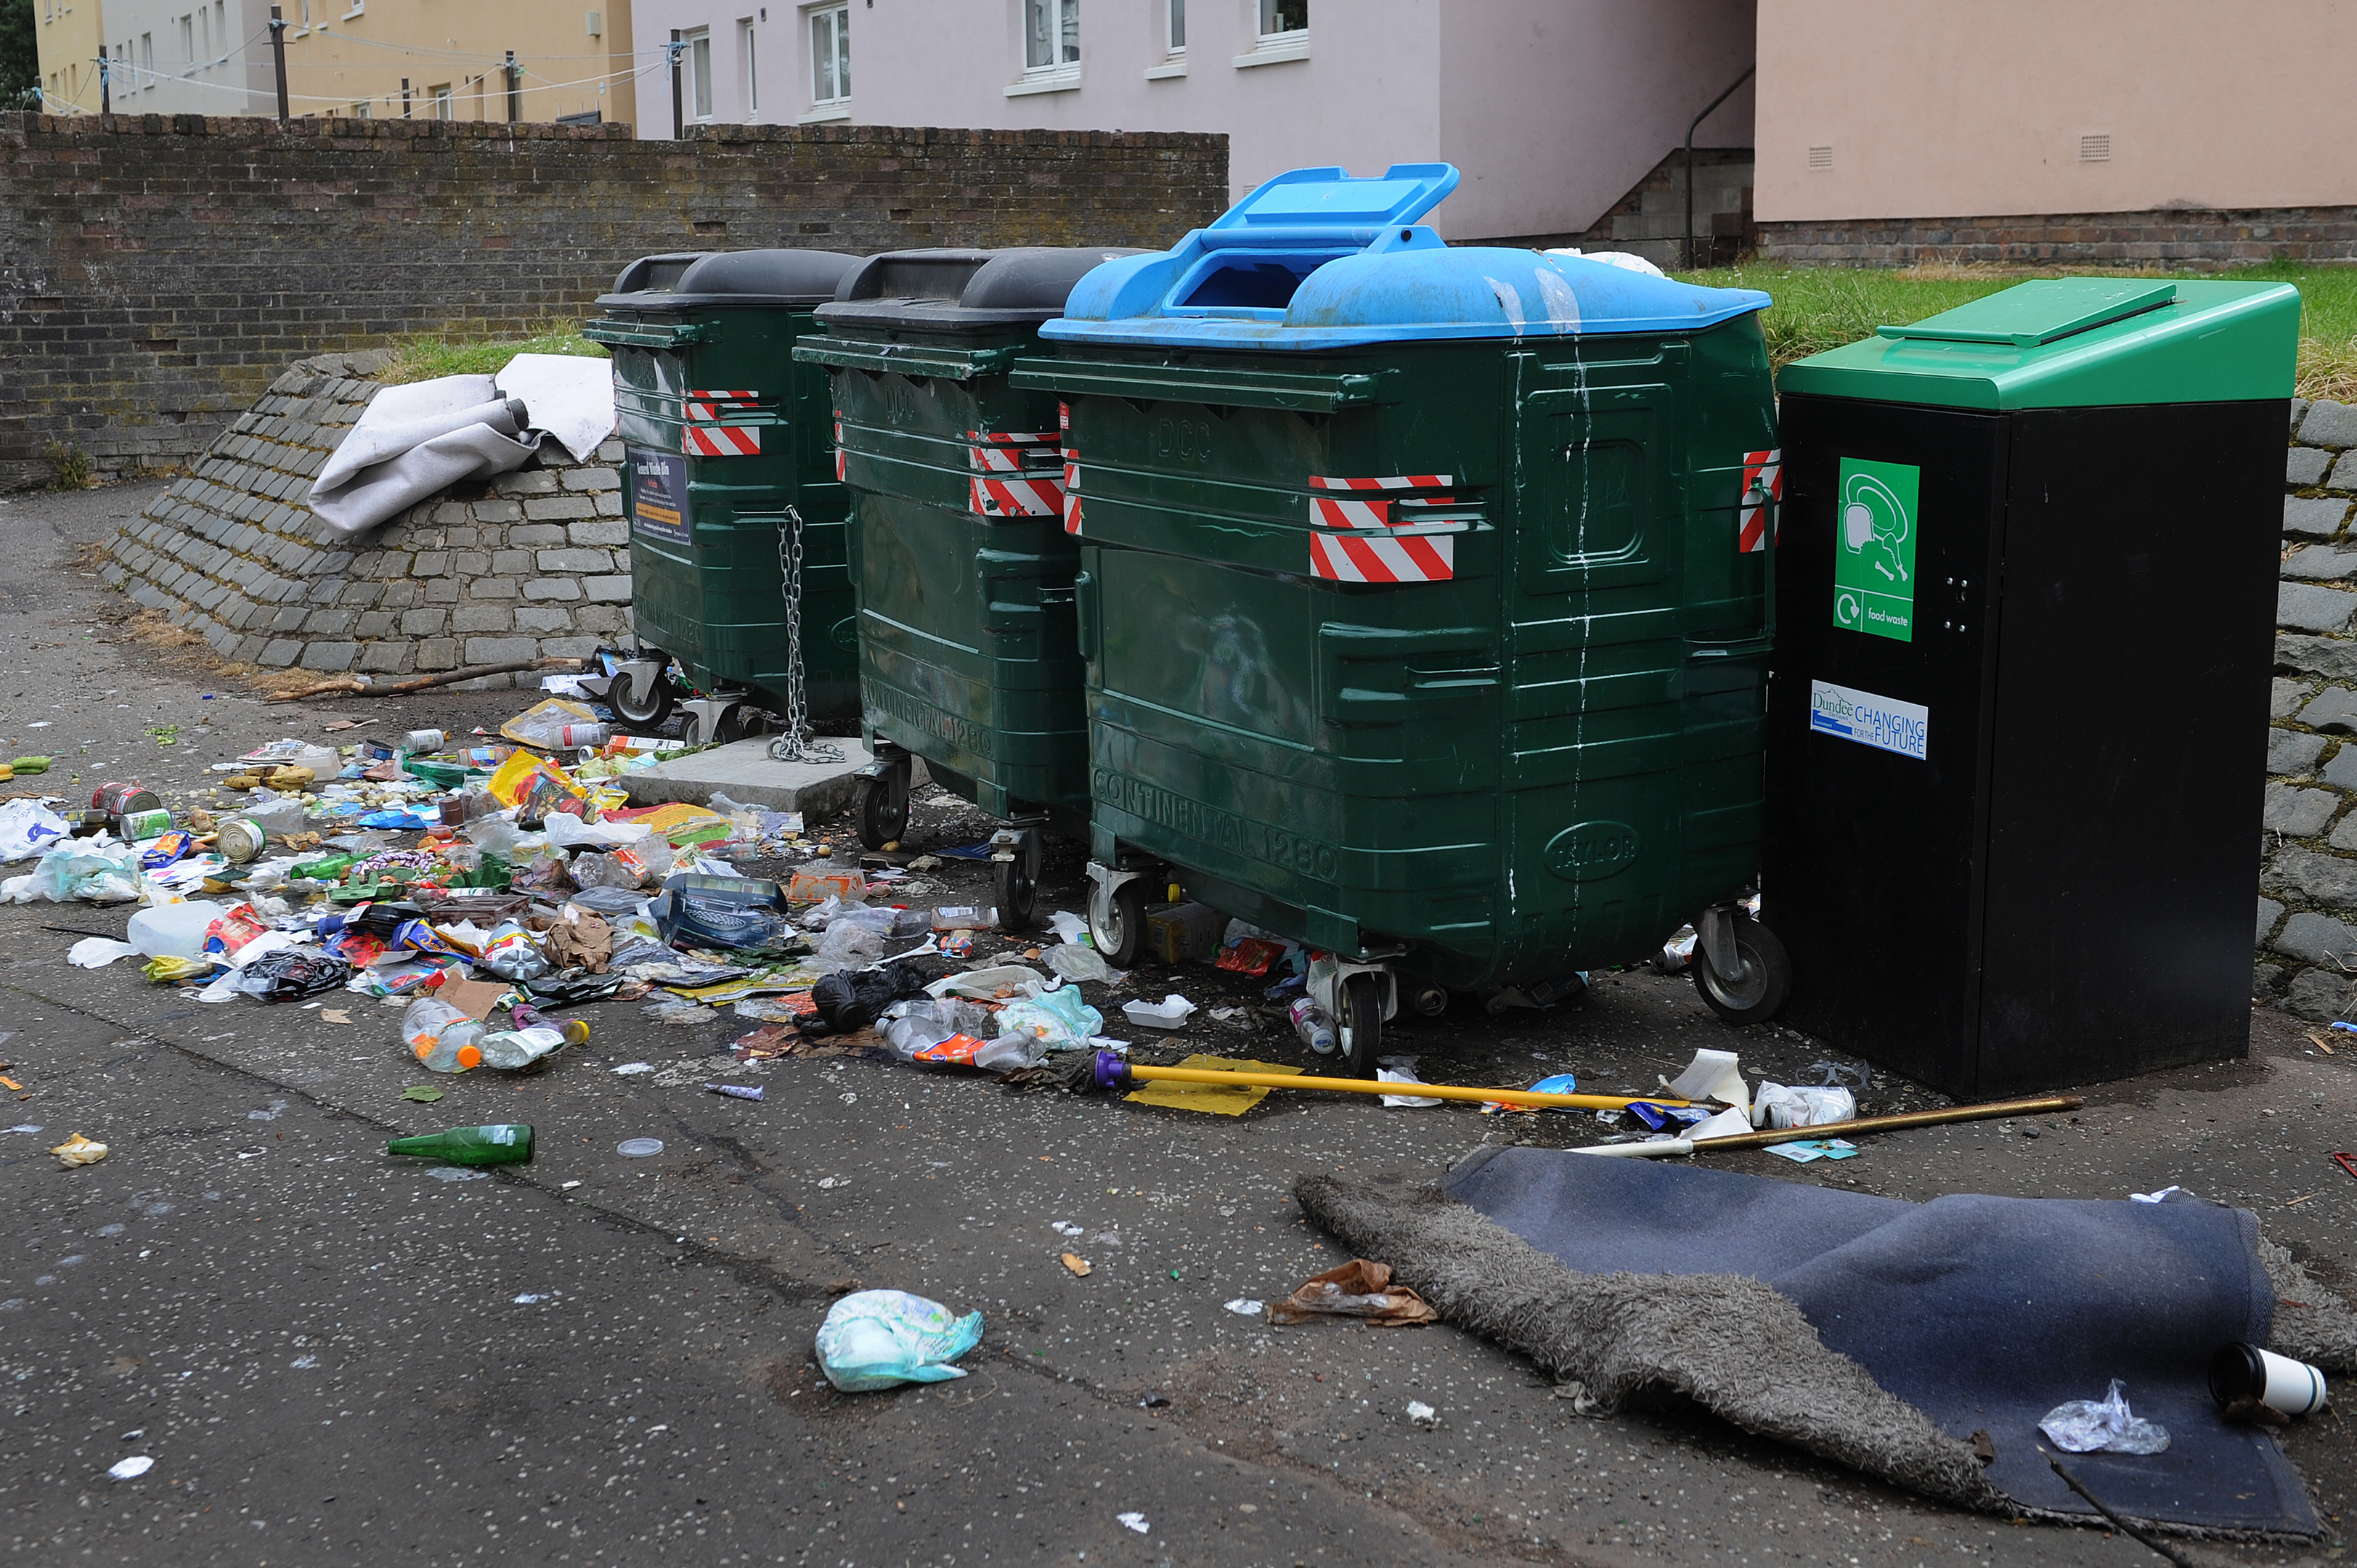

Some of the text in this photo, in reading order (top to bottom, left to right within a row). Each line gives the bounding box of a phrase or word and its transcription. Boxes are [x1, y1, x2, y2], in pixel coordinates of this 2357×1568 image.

[1158, 418, 1211, 462] DCC
[1868, 607, 1908, 626] food waste
[860, 674, 993, 758] CONTINENTAL 1280
[1813, 693, 1853, 716] Dundee
[1855, 706, 1924, 738] CHANGING
[1854, 727, 1924, 755] FOR THE FUTURE
[1091, 767, 1338, 881] CONTINENTAL 1280
[1552, 836, 1636, 868] TAYLOR
